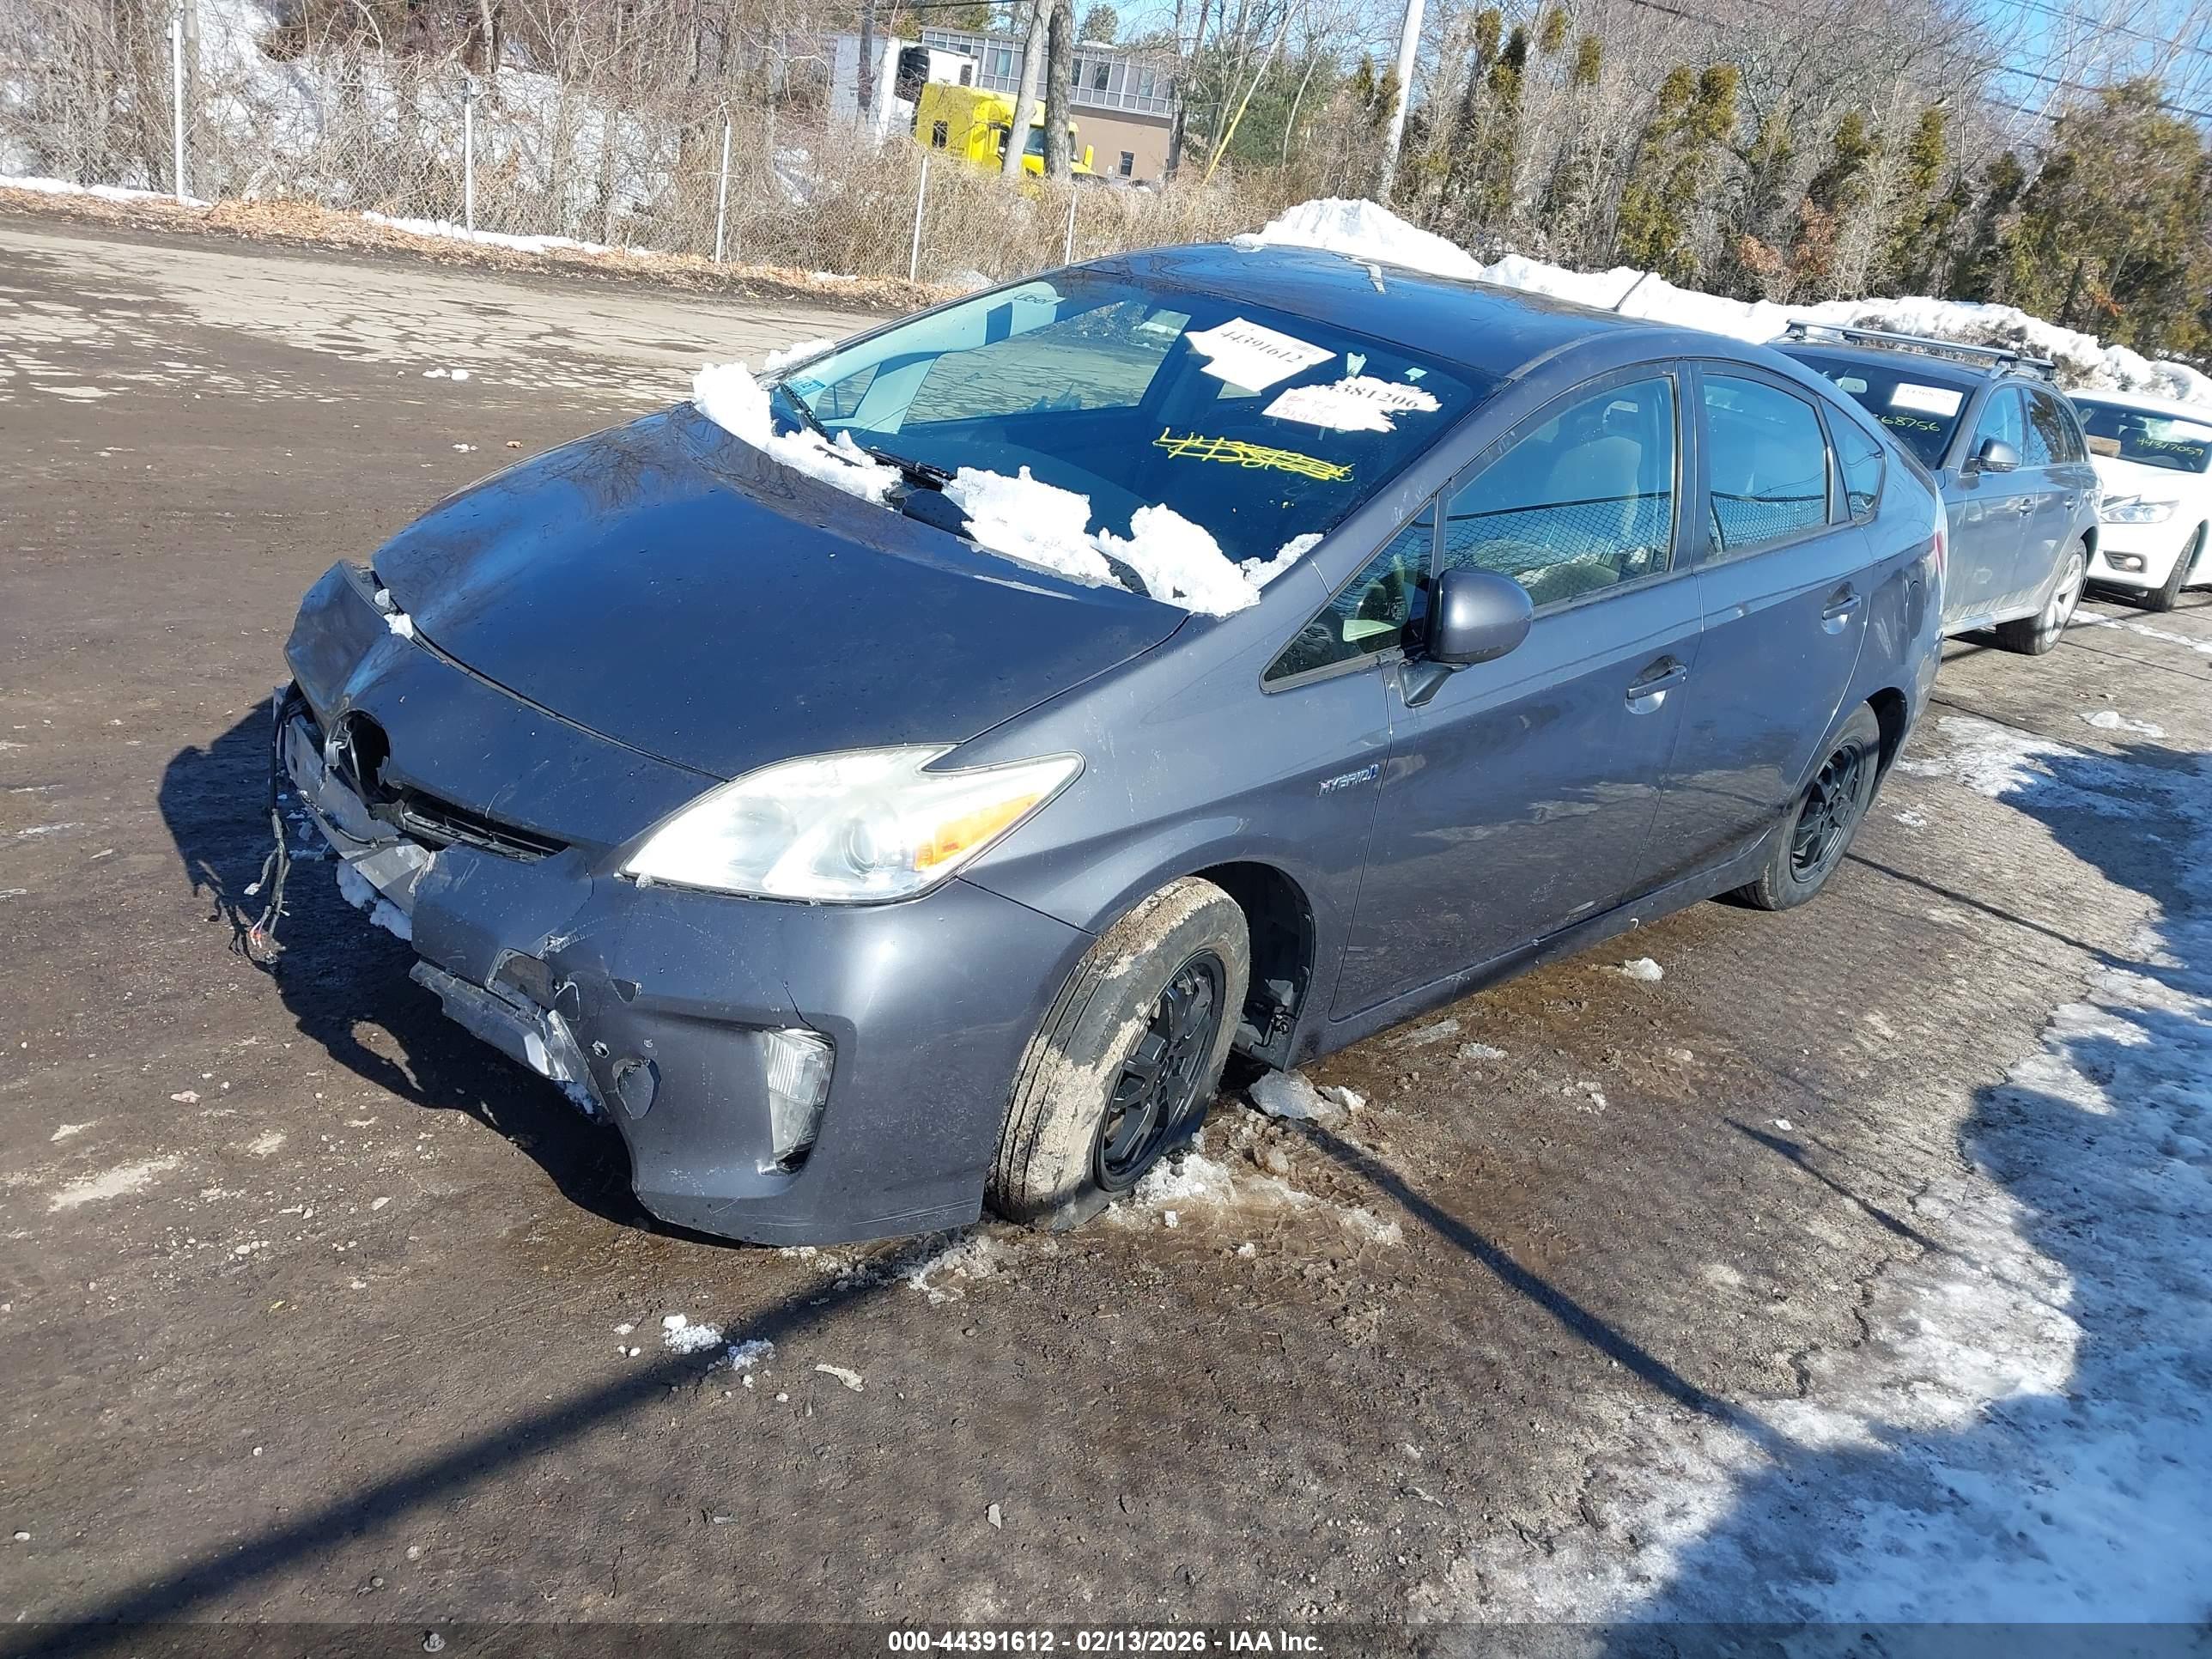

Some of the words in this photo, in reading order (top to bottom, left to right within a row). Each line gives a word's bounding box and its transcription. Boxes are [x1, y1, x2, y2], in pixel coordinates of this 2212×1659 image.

[1013, 293, 1054, 305] Uber
[1220, 331, 1304, 364] 44391612
[2136, 437, 2204, 457] 44317059
[1316, 767, 1374, 797] HYBRID
